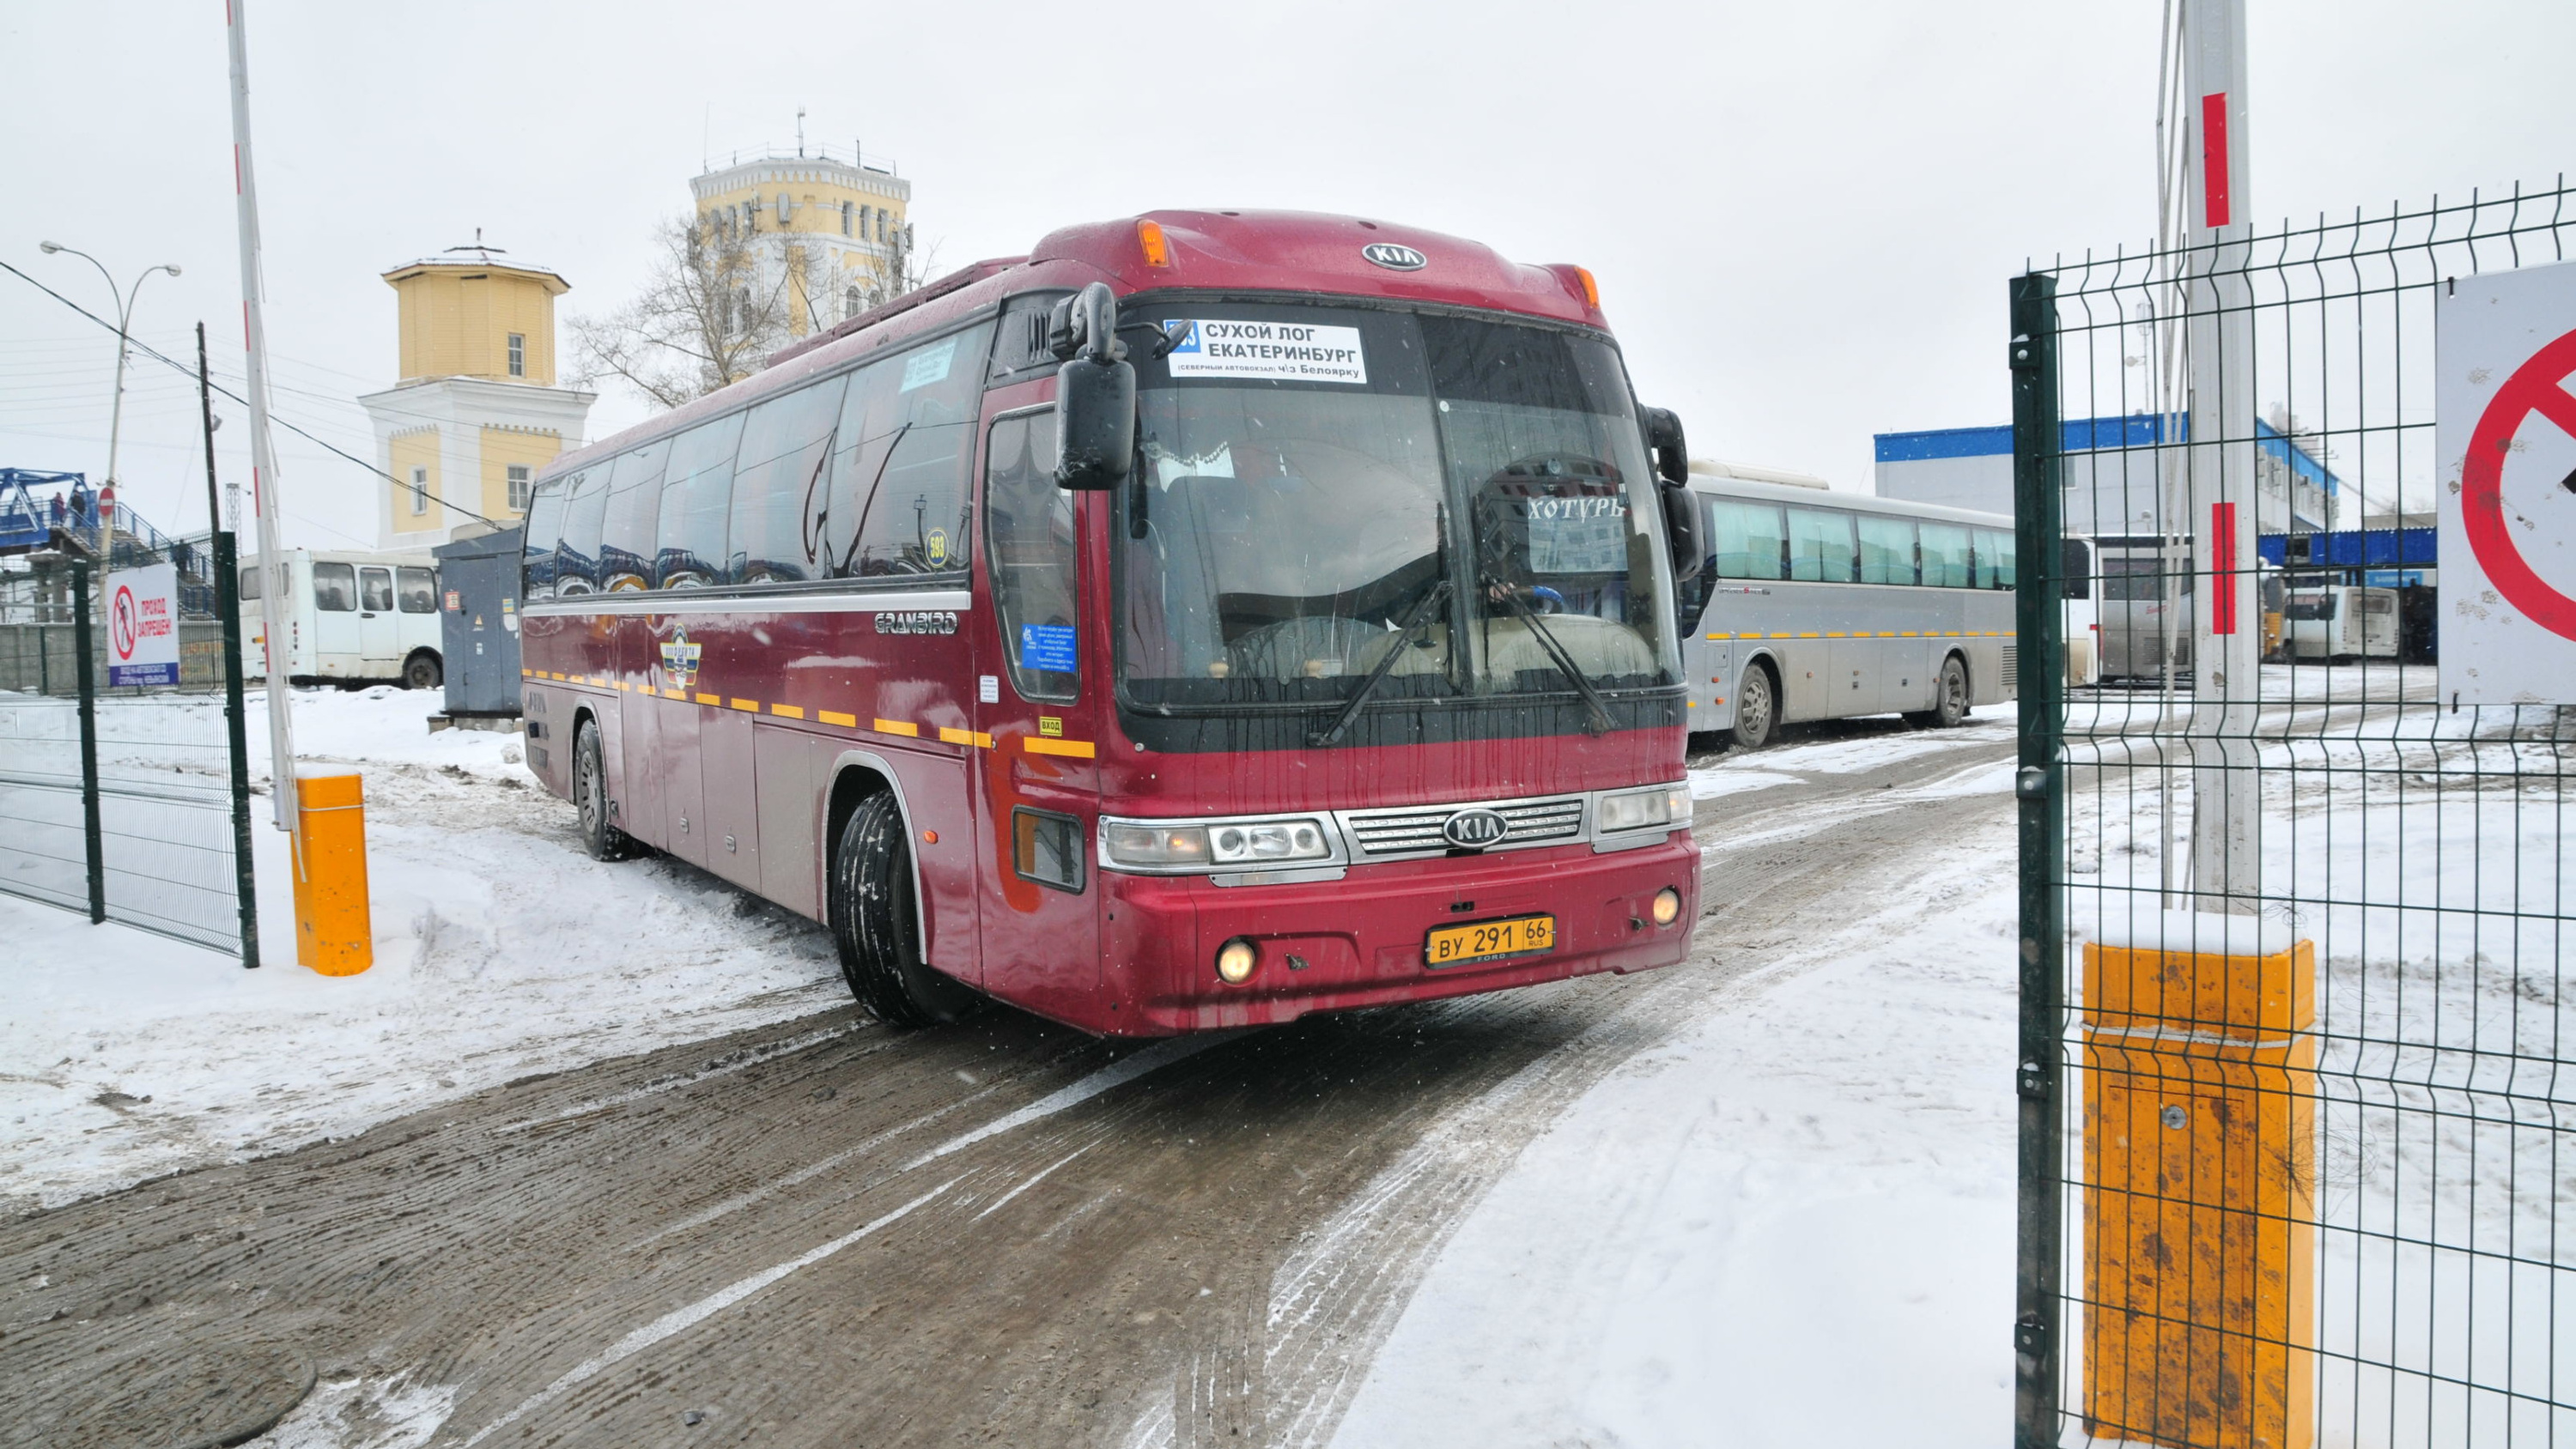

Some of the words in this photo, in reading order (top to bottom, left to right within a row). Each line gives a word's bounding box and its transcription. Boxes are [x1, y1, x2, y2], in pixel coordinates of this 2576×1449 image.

[1372, 246, 1420, 264] KIA
[1205, 323, 1273, 340] СУХОЙ
[1279, 327, 1315, 342] ЛОГ
[1208, 343, 1357, 363] ЕКАТЕРИНБУРГ
[1300, 365, 1359, 379] Белоярку
[930, 536, 945, 558] 593
[142, 598, 166, 616] ПРОХОД
[874, 612, 957, 634] GRANBIRD
[1042, 720, 1060, 732] ВХОД
[1456, 817, 1499, 840] KIA
[1473, 925, 1512, 953] 291
[1526, 920, 1546, 939] 66
[1477, 953, 1506, 962] FORD
